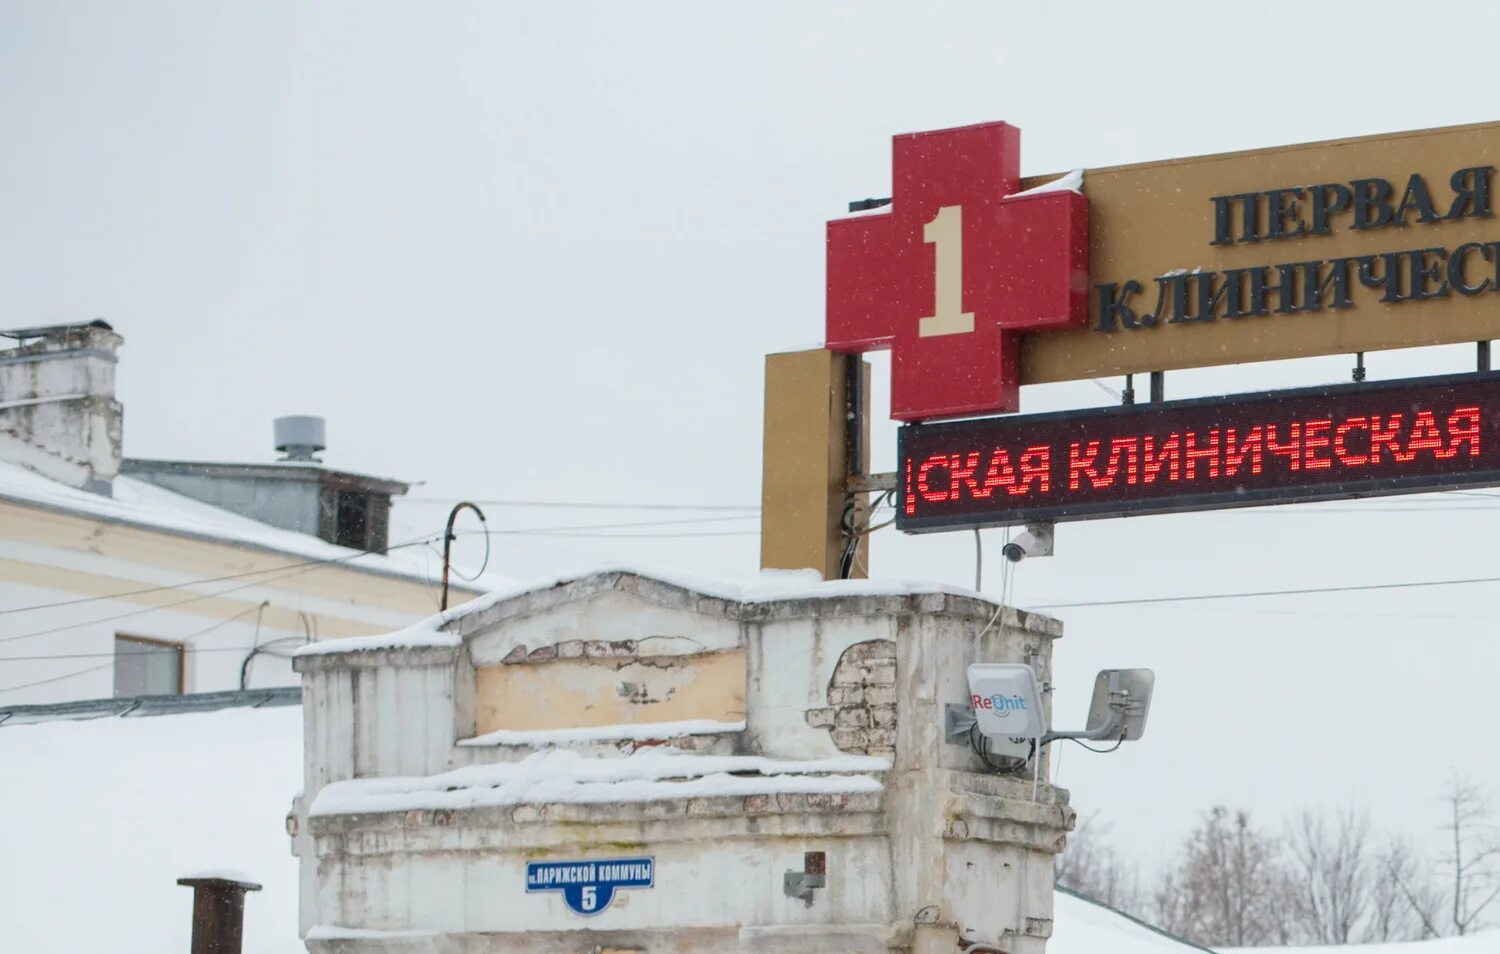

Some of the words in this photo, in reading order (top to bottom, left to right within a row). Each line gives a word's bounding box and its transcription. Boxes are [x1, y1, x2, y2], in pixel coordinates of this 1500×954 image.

[1210, 165, 1495, 247] ПЕРВАЯ
[918, 204, 976, 338] 1
[905, 444, 1051, 516] СКАЯ
[1069, 406, 1481, 490] КЛИНИЧЕСКАЯ
[972, 694, 1027, 711] ReUnit
[537, 863, 596, 884] ПАРИЖСКОЙ
[600, 863, 651, 882] КОММУНЫ
[582, 886, 597, 911] 5
